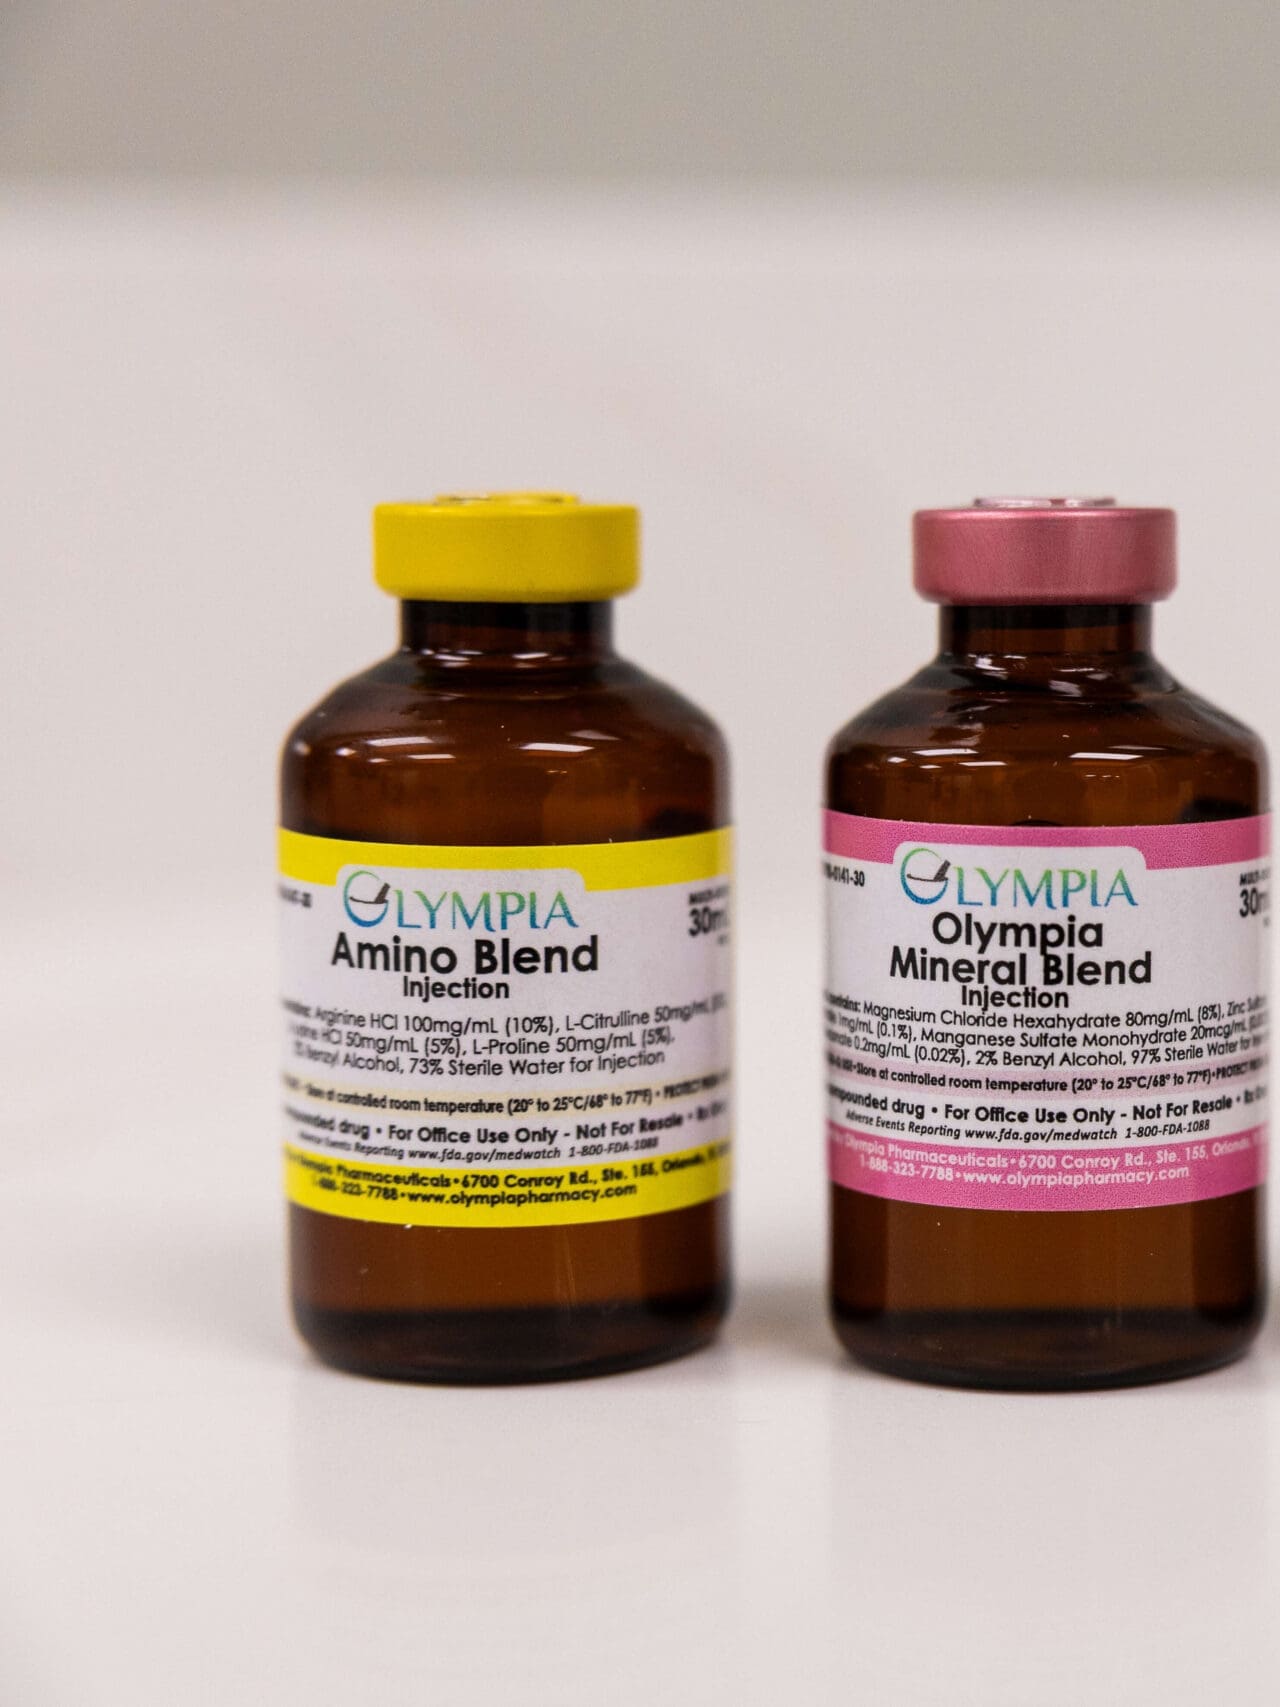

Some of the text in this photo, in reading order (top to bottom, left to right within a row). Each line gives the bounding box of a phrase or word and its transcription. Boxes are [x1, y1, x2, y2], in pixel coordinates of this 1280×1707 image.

[932, 912, 1102, 954] Olympia
[332, 932, 598, 974] Amino Blend
[890, 945, 1152, 986] Mineral Blend
[403, 976, 509, 1002] Injection
[962, 986, 1069, 1010] Injection
[315, 1008, 366, 1027] Arginine
[371, 1013, 398, 1030] HCl
[405, 1015, 499, 1037] 100mg/mL
[506, 1016, 560, 1037] (10%),
[566, 1010, 650, 1030] L-Citrulline
[863, 1001, 935, 1023] Magnesium
[941, 1010, 1007, 1028] Chloride
[1013, 1014, 1120, 1031] Hexahydrate
[1125, 1008, 1193, 1027] 80mg/mL
[1227, 1001, 1245, 1017] Zinc
[346, 1033, 636, 1057] 50mg/mL (5%), L-Proline 50mg/mL
[877, 1021, 917, 1042] (0.1%),
[920, 1028, 1015, 1047] Manganese
[1020, 1032, 1077, 1048] Sulfate
[1082, 1028, 1186, 1047] Monohydrate
[1190, 1020, 1246, 1040] 20mcg/mL
[343, 1051, 664, 1076] Alcohol, 73% Sterile Water for Injection
[854, 1039, 1237, 1069] 0.2mg/mL (0.02%), 2% Benzyl Alcohol, 97% Sterile Water
[879, 1068, 1184, 1093] at controlled room temperature to to
[390, 1096, 420, 1111] room
[424, 1099, 504, 1116] temperature
[537, 1099, 549, 1112] to
[892, 1096, 1232, 1125] drug For Office Use Only Not For Resale
[339, 1113, 683, 1144] drug For Office Use Only Not For Resale
[876, 1117, 904, 1132] Events
[908, 1123, 961, 1139] Reporting
[965, 1128, 1118, 1144] www.fda.gov/medwatch
[1125, 1120, 1209, 1139] 1-800-FDA-1088
[354, 1142, 560, 1163] Reporting www.fda.gov/medwatch
[1061, 1155, 1120, 1169] Conroy
[1156, 1150, 1181, 1164] Ste.
[504, 1168, 627, 1188] Conroy Rd., Ste.
